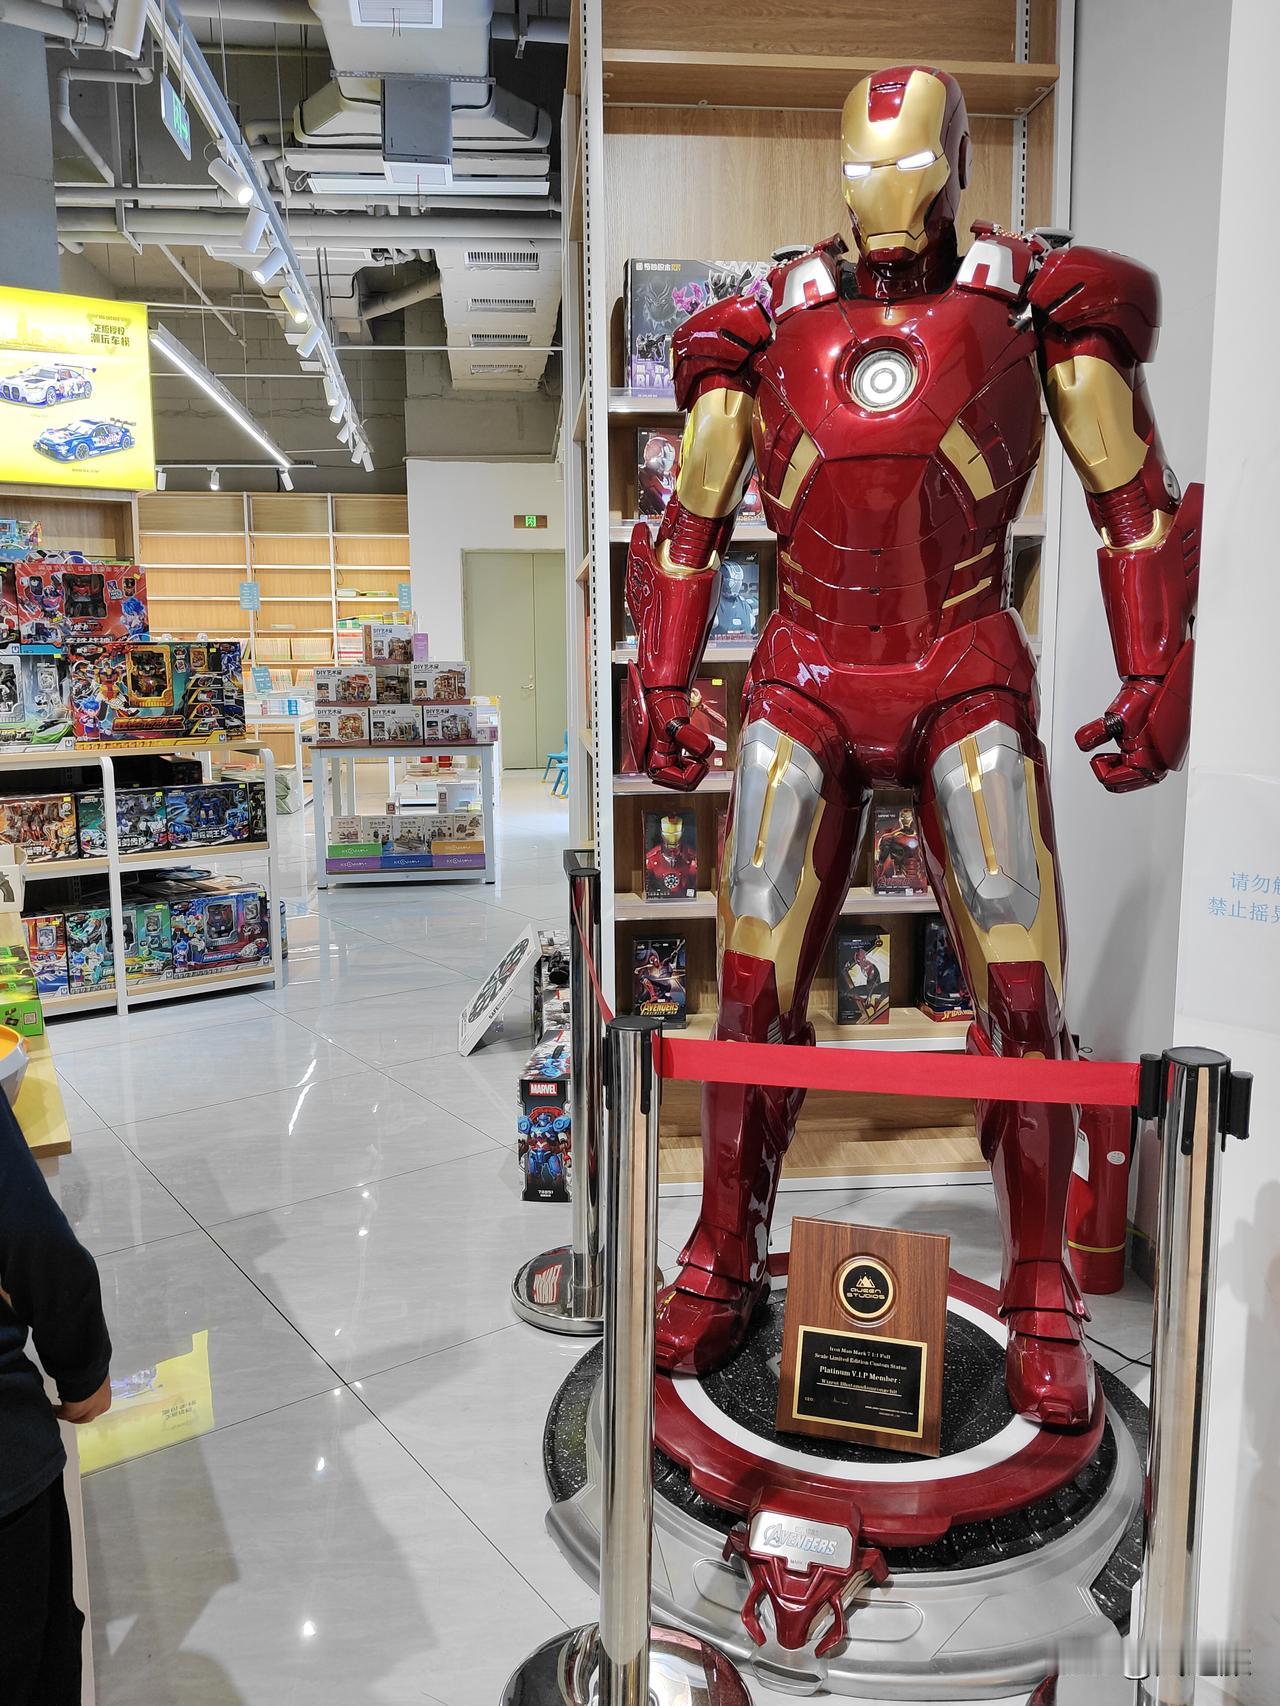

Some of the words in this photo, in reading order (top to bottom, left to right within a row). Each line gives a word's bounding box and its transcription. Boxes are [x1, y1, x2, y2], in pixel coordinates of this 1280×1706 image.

[530, 1083, 557, 1095] MARVEL
[846, 1292, 885, 1300] STUDIOS
[829, 1354, 849, 1362] Limited
[849, 1357, 869, 1365] Edition
[890, 1363, 907, 1371] Statue
[819, 1365, 851, 1377] Platinum
[763, 1522, 838, 1556] AVENGERS
